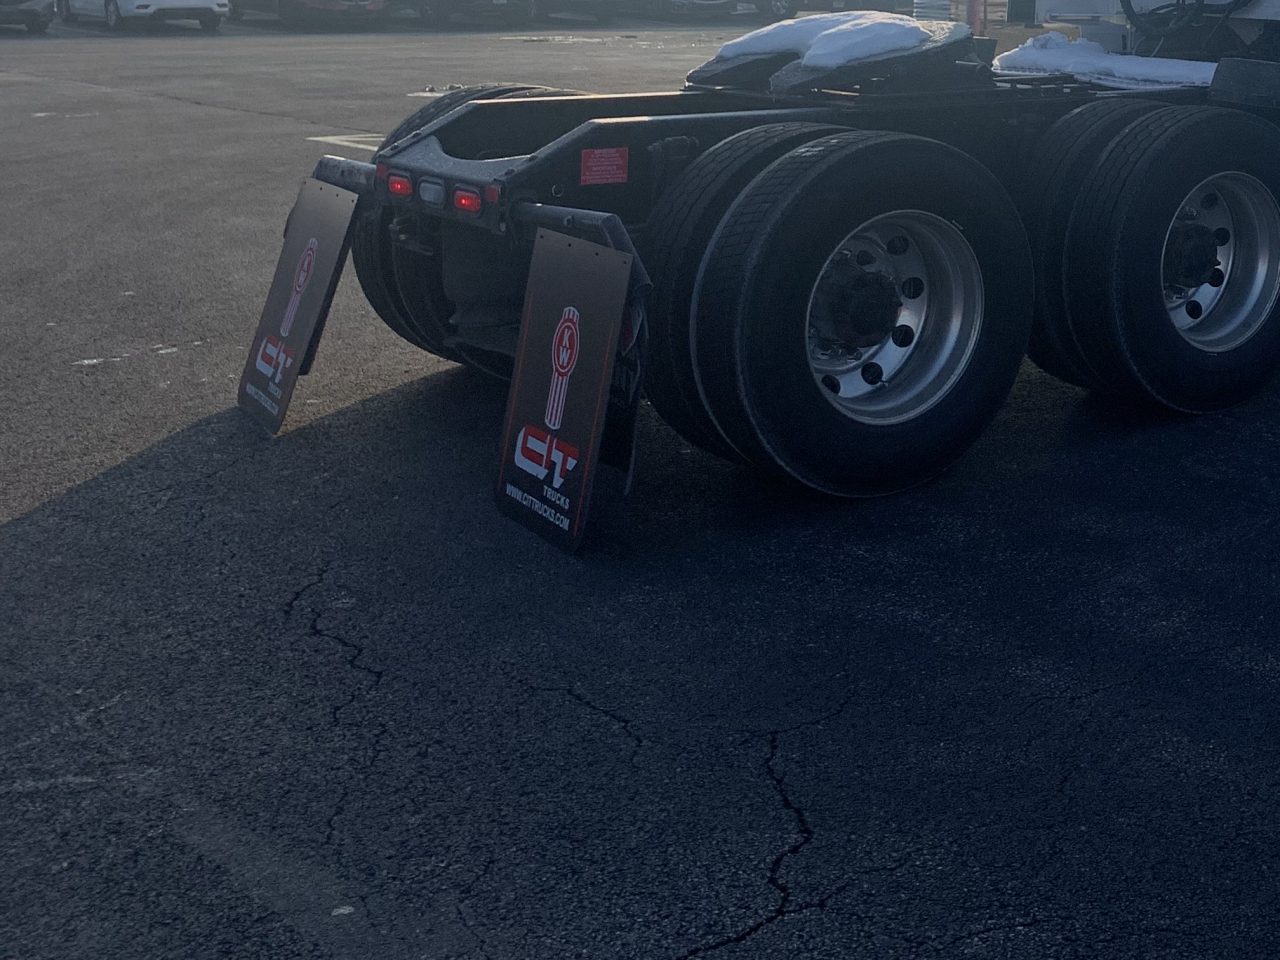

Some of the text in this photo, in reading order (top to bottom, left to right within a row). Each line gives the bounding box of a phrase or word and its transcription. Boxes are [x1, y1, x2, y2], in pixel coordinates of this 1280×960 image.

[514, 423, 580, 489] CIT
[506, 483, 570, 532] WWW.CITTRUCKS.COM
[543, 484, 570, 510] TRUCKS
